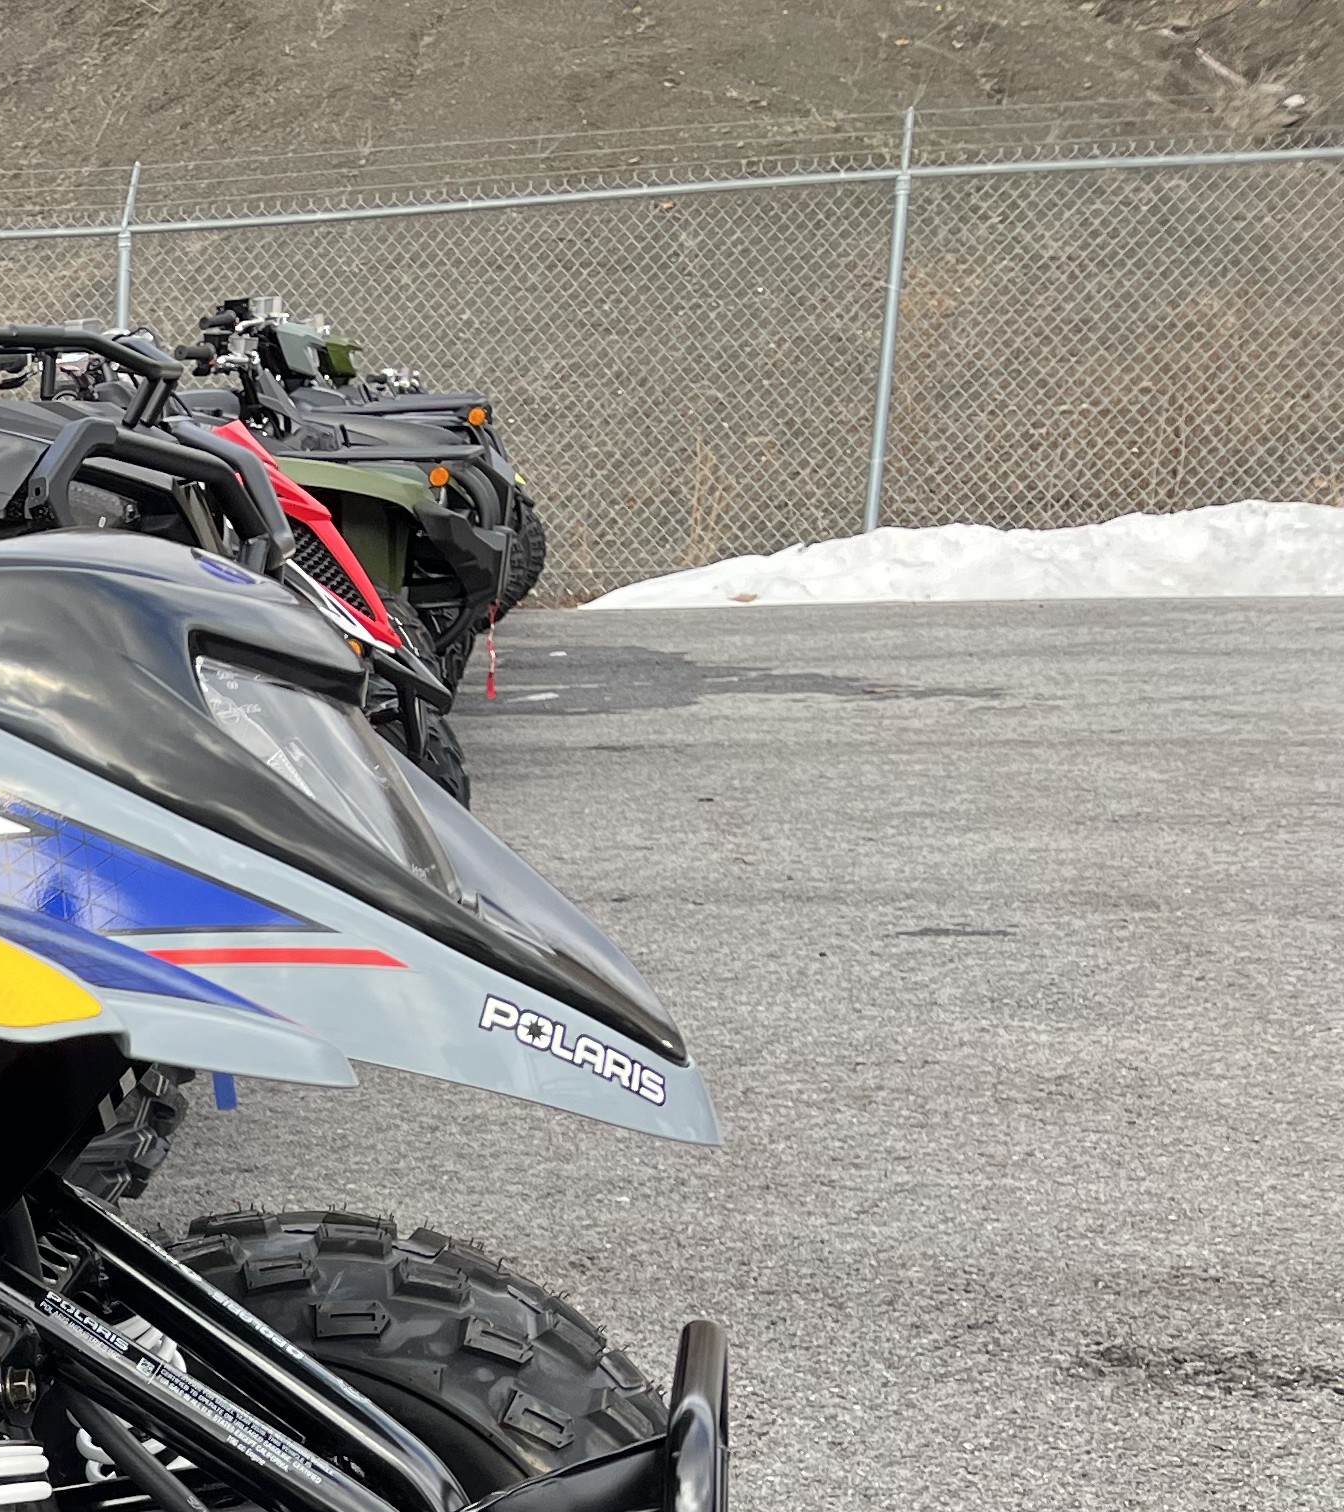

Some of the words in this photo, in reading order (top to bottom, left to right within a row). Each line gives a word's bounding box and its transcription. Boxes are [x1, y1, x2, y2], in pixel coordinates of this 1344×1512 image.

[480, 993, 667, 1106] POLARIS
[44, 1289, 130, 1352] POLARIS
[210, 1289, 287, 1348] POLARIS
